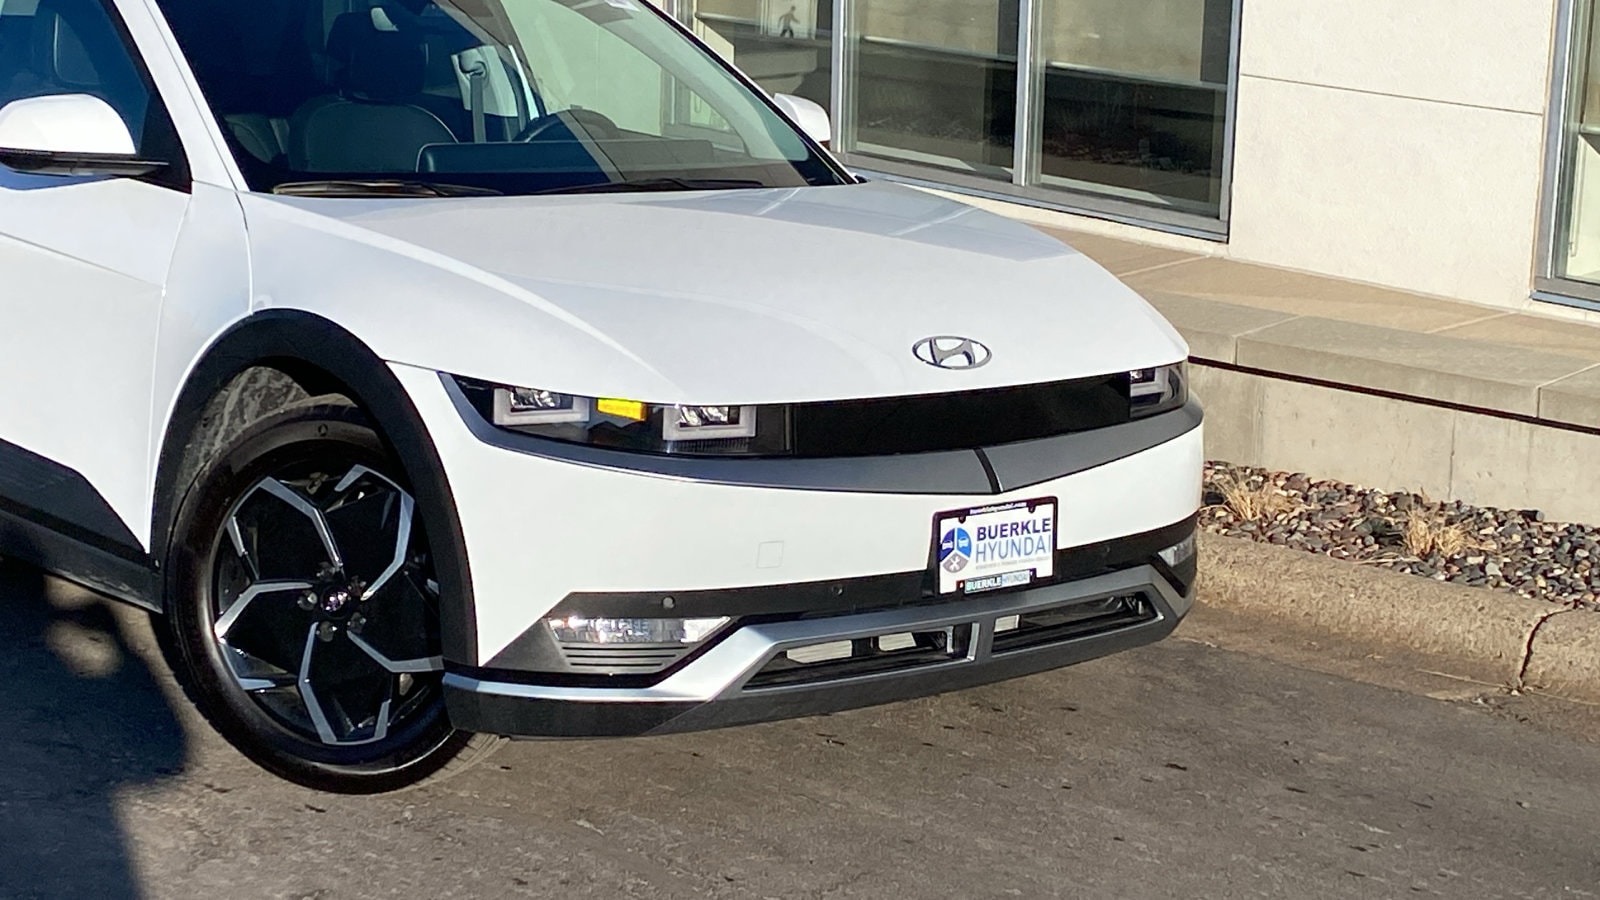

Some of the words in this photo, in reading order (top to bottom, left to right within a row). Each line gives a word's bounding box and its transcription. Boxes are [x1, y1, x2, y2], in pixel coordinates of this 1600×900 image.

[977, 518, 1052, 541] BUERKLE
[975, 535, 1051, 563] HYUNDAI
[966, 576, 1002, 592] BUERKLE
